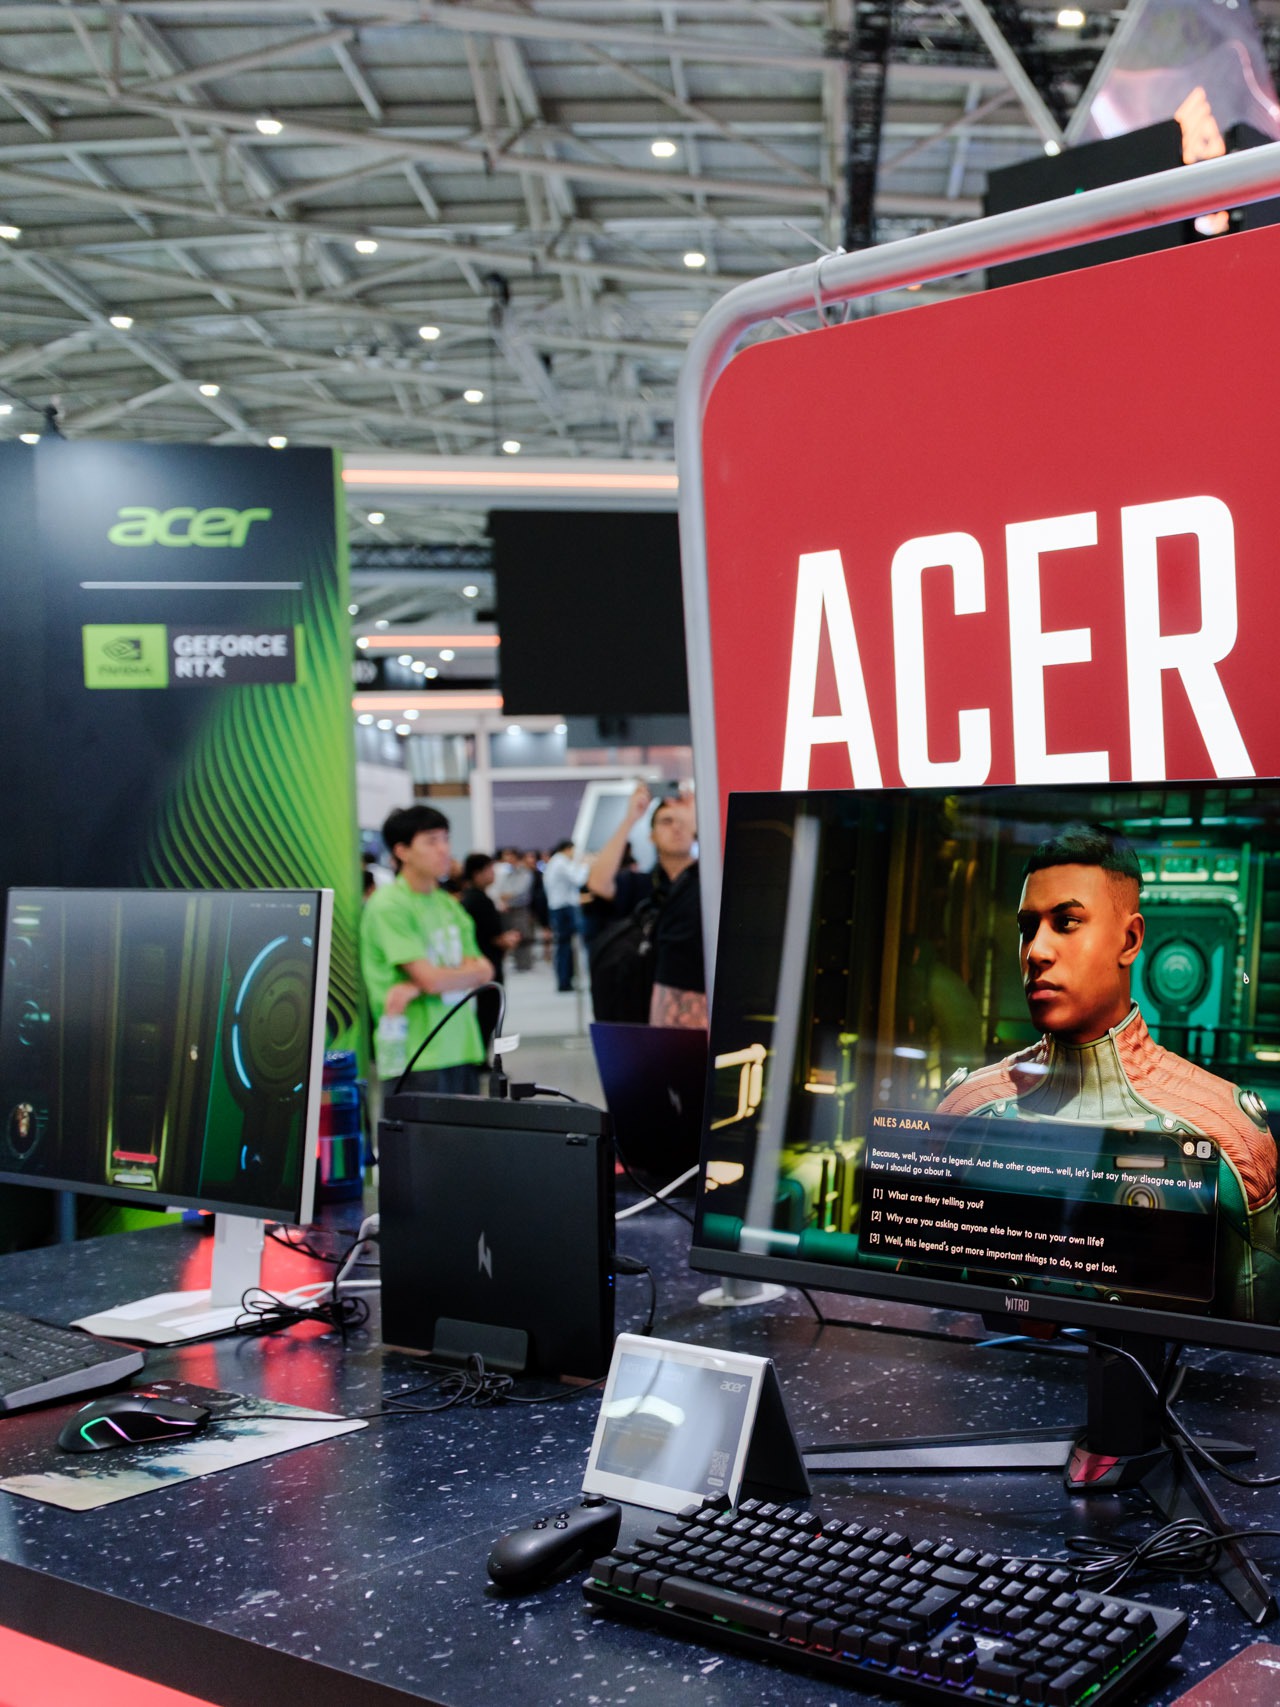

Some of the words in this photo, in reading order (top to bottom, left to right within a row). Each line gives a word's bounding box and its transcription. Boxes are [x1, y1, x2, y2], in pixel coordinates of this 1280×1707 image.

[107, 506, 272, 547] acer
[172, 634, 288, 657] GEFORCE
[781, 497, 1257, 791] ACER
[174, 656, 226, 679] RTX
[873, 1116, 897, 1128] NILES
[899, 1118, 931, 1131] ABARA
[870, 1161, 885, 1170] how
[890, 1163, 911, 1173] should
[924, 1166, 944, 1176] about
[872, 1148, 900, 1160] Because,
[902, 1152, 917, 1162] well,
[919, 1153, 940, 1164] you're
[949, 1156, 974, 1168] legend.
[976, 1159, 991, 1168] And
[993, 1160, 1004, 1169] the
[1006, 1162, 1024, 1171] other
[1056, 1166, 1073, 1177] well,
[1075, 1167, 1090, 1178] let's
[1091, 1169, 1104, 1180] just
[1105, 1172, 1119, 1182] say
[1121, 1172, 1138, 1184] they
[1140, 1174, 1175, 1188] disagree
[1176, 1180, 1187, 1188] on
[1188, 1179, 1202, 1190] just
[872, 1188, 884, 1200] [1]
[887, 1190, 909, 1201] What
[910, 1194, 923, 1202] are
[924, 1194, 940, 1206] they
[942, 1196, 965, 1209] telling
[966, 1200, 985, 1210] you?
[871, 1210, 882, 1222] [2]
[886, 1212, 903, 1225] Why
[905, 1216, 918, 1225] are
[920, 1219, 933, 1227] you
[935, 1219, 959, 1231] asking
[960, 1223, 988, 1234] anyone
[990, 1225, 1005, 1235] else
[1007, 1226, 1022, 1237] how
[1024, 1229, 1033, 1239] to
[1035, 1232, 1047, 1240] run
[1049, 1233, 1067, 1244] your
[1068, 1236, 1085, 1245] own
[1087, 1236, 1105, 1247] life?
[869, 1233, 880, 1244] [3]
[884, 1235, 903, 1247] Well,
[904, 1237, 917, 1247] this
[918, 1239, 949, 1252] legend's
[951, 1245, 964, 1254] got
[965, 1248, 985, 1256] more
[986, 1248, 1023, 1261] important
[1025, 1252, 1047, 1265] things
[1049, 1256, 1058, 1266] to
[1059, 1257, 1072, 1269] do,
[1074, 1261, 1084, 1269] so
[1086, 1262, 1099, 1272] get
[1101, 1262, 1118, 1274] lost.
[1005, 1295, 1030, 1312] NITRO
[720, 1380, 746, 1393] acer
